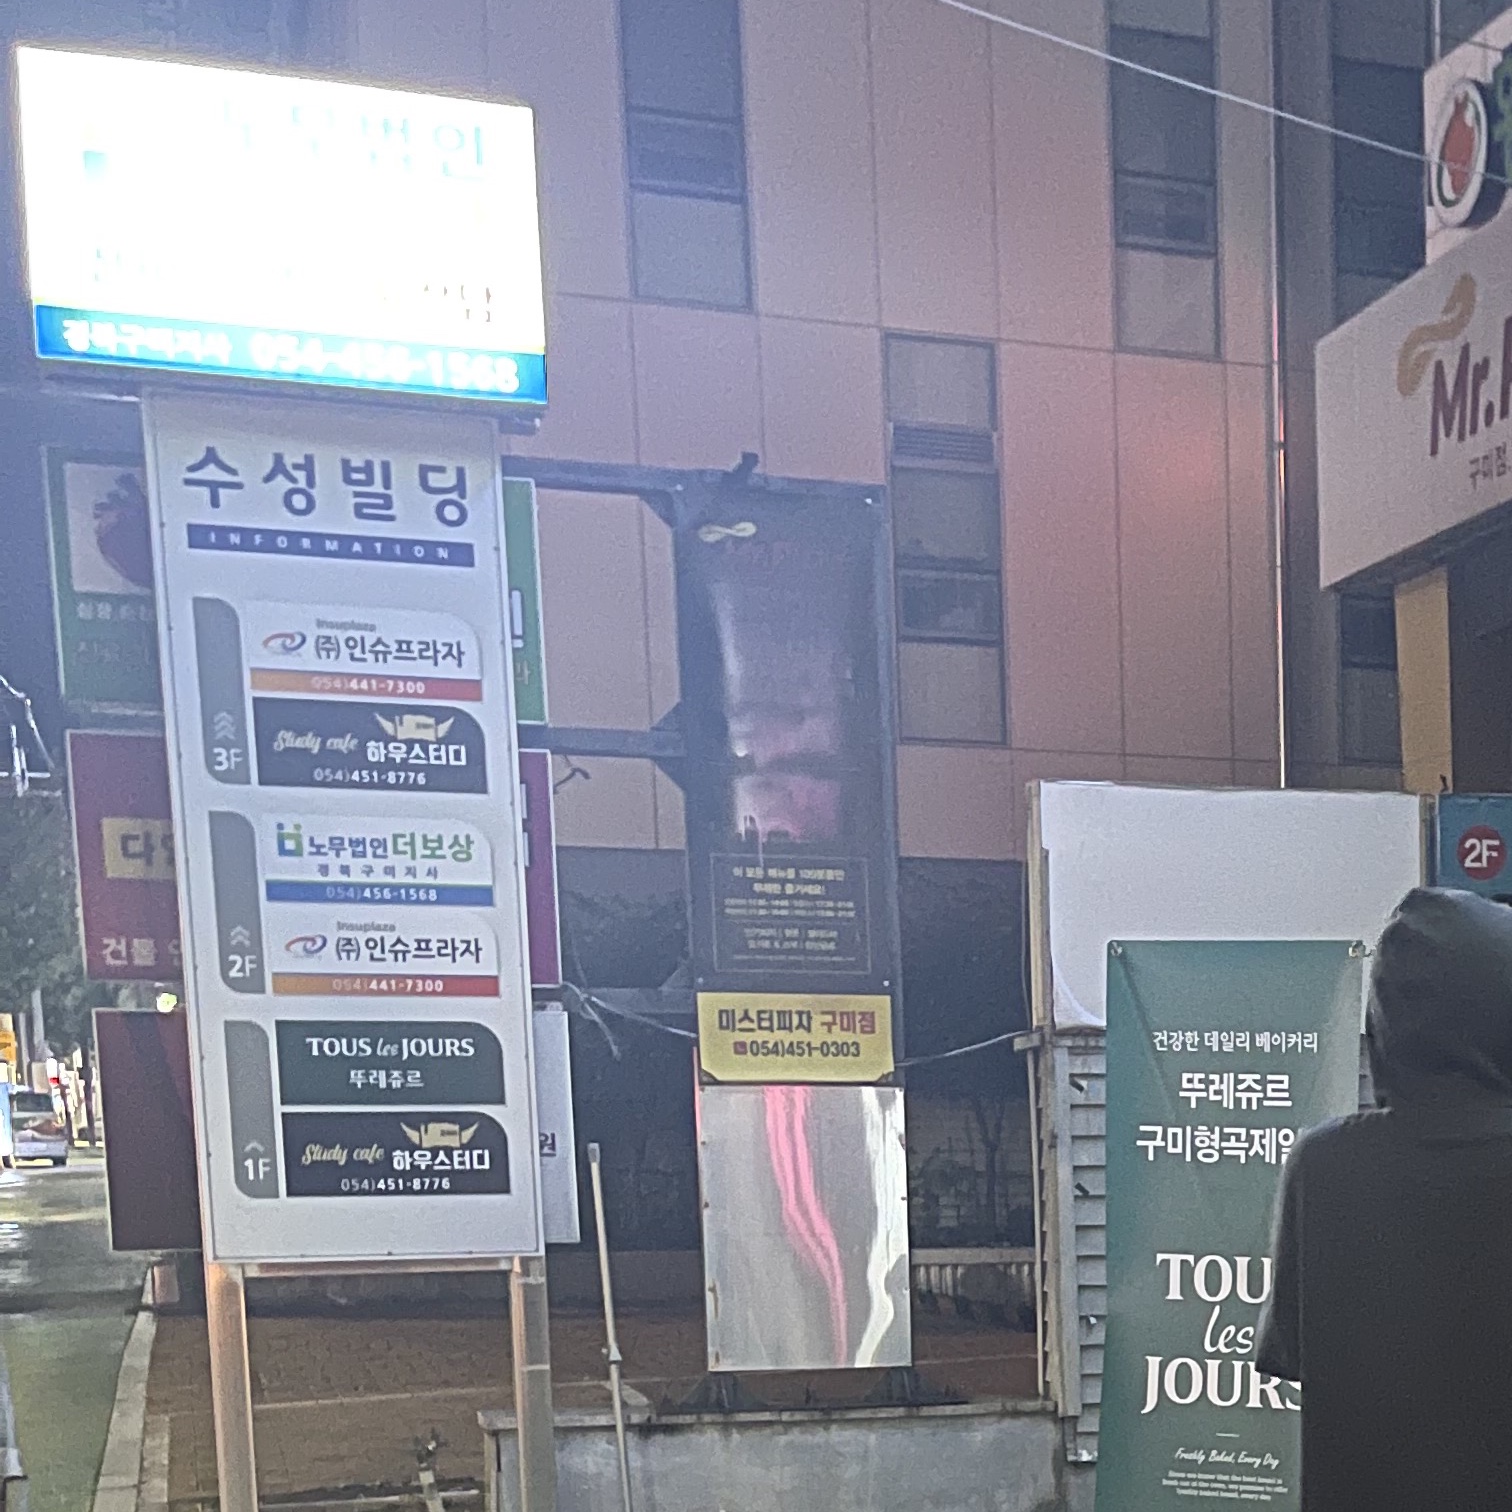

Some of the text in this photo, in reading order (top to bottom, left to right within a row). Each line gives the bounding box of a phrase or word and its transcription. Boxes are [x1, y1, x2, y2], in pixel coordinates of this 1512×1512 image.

[183, 446, 470, 528] 수성빌딩
[209, 532, 450, 560] INFORMATION
[213, 747, 243, 772] 3F
[366, 741, 468, 767] 하우스터디
[313, 767, 427, 785] 054)451-8776
[1464, 838, 1500, 869] 2F
[326, 886, 439, 902] 054)456-1568
[227, 954, 258, 979] 2F
[717, 1008, 877, 1035] 미스터피자 구미점
[305, 1036, 373, 1058] TOUS
[401, 1037, 476, 1062] JOURS
[749, 1040, 861, 1059] 054)451-0303
[1152, 1030, 1319, 1054] 건강한 데일리 베이커리
[348, 1069, 425, 1090] 뚜레쥬르
[1178, 1071, 1293, 1111] 뚜레쥬르
[243, 1156, 271, 1182] 1F
[391, 1147, 491, 1172] 하우스터디
[340, 1177, 451, 1193] 054)451-8776
[1203, 1304, 1255, 1356] les
